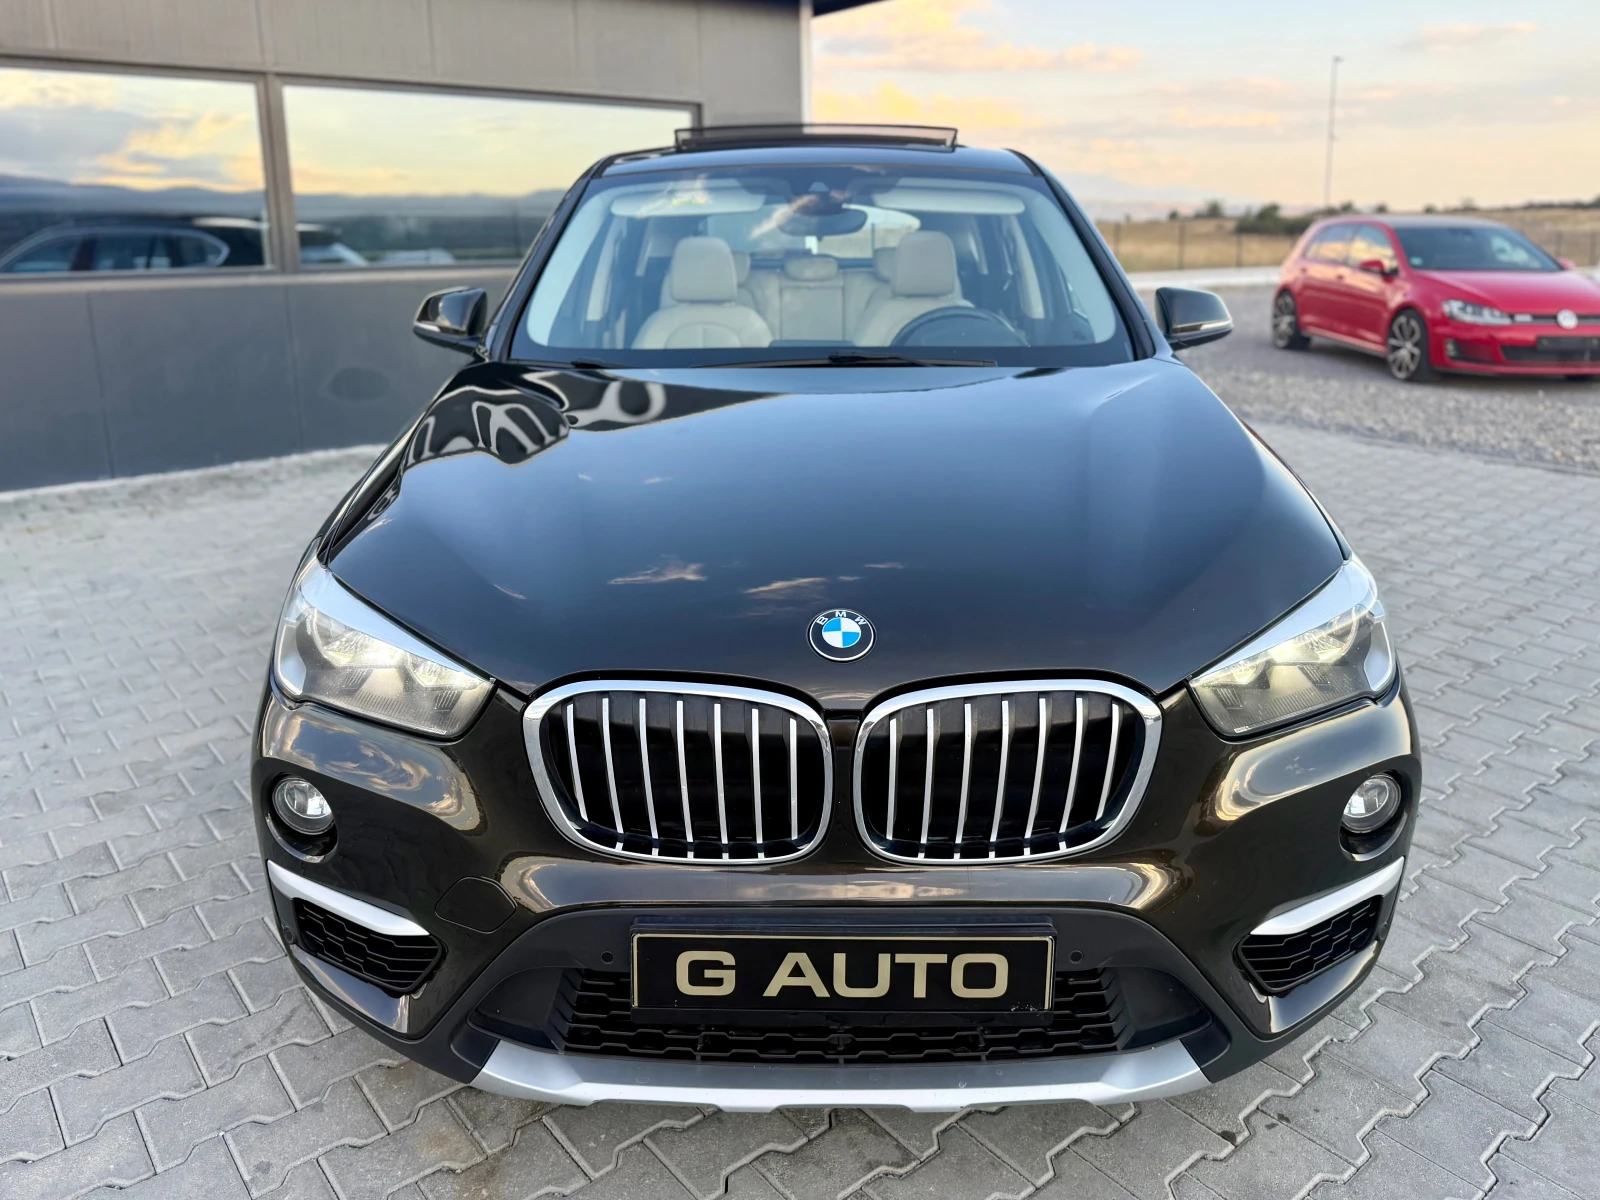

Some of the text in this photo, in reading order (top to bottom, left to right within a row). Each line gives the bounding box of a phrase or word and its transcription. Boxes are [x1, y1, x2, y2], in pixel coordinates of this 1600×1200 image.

[815, 611, 867, 625] BMW
[676, 950, 1009, 998] G AUTO
